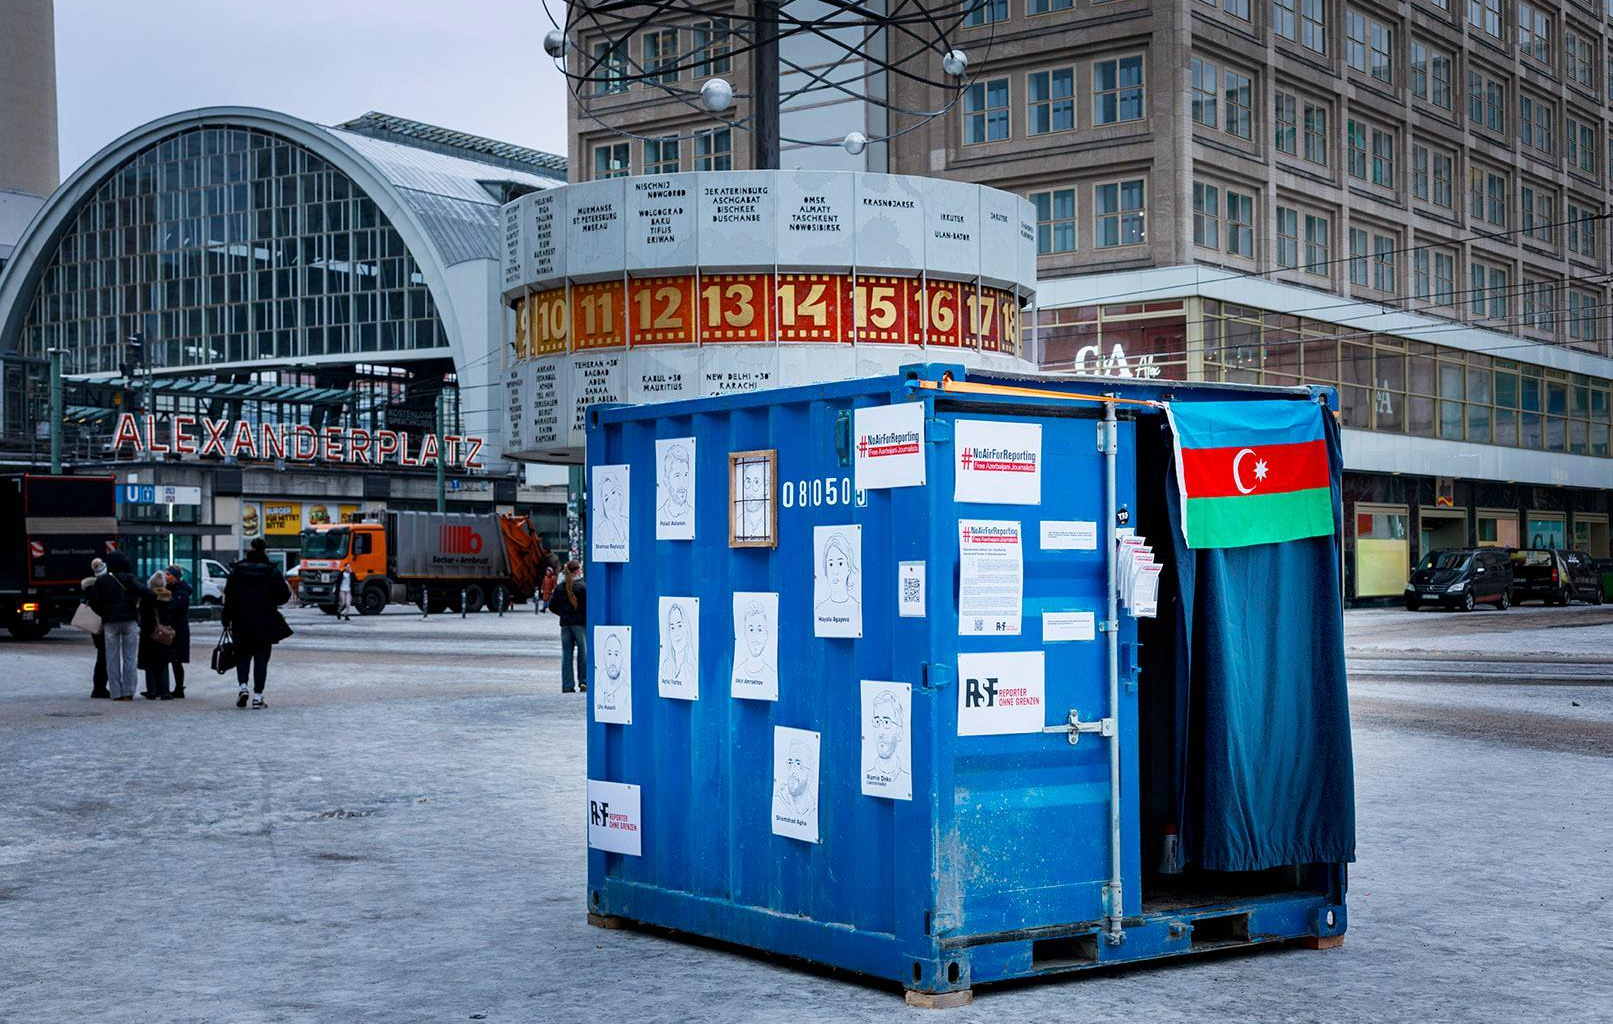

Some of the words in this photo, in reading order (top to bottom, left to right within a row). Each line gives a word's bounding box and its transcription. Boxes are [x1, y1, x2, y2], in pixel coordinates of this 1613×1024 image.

[635, 181, 670, 191] NISCHNIJ
[647, 189, 686, 199] NOWGOROD
[704, 187, 768, 196] JEKATERINBURG
[712, 196, 761, 204] ASCHGABAT
[804, 196, 826, 204] OMSK
[863, 198, 915, 209] KRASNOJARSK
[577, 204, 612, 215] MURMANSK
[639, 207, 683, 217] WOLGOGRAD
[716, 205, 755, 213] BISCHKEK
[799, 205, 831, 213] ALMATY
[651, 217, 671, 226] BAKU
[712, 214, 761, 222] DUSCHANBE
[792, 214, 839, 223] TASCHKENT
[582, 222, 607, 232] MOSKAU
[650, 225, 671, 235] TIFLIS
[789, 223, 841, 232] NOWOSIBIRSK
[646, 234, 675, 244] ERIWAN
[634, 286, 683, 330] 12
[702, 283, 755, 328] 13
[777, 284, 827, 327] 14
[849, 286, 897, 329] 15
[914, 289, 955, 332] 16
[581, 292, 613, 335] 11
[966, 294, 995, 337] 17
[539, 300, 566, 341] 10
[575, 360, 604, 369] TEHERAN
[584, 369, 609, 377] BAGDAD
[589, 378, 606, 386] ADEN
[642, 374, 666, 383] KABUL
[643, 383, 683, 391] MAURITIUS
[719, 382, 758, 390] KARACHI
[585, 387, 608, 396] SANAA
[576, 396, 595, 404] ADDIS
[597, 395, 618, 403] ABEBA
[113, 412, 485, 470] ALEXANDERPLATZ
[859, 431, 920, 458] #NoAirForReporting
[961, 447, 1037, 471] #NoAirForReporting
[127, 486, 139, 503] U
[965, 677, 998, 708] RSF
[999, 688, 1027, 698] REPORTER
[999, 698, 1014, 707] OHNE
[1015, 696, 1040, 706] GRENZEN
[590, 800, 608, 828] RSF
[609, 813, 628, 822] REPORTER
[609, 821, 620, 830] OHNE
[620, 822, 637, 832] GRENZEN
